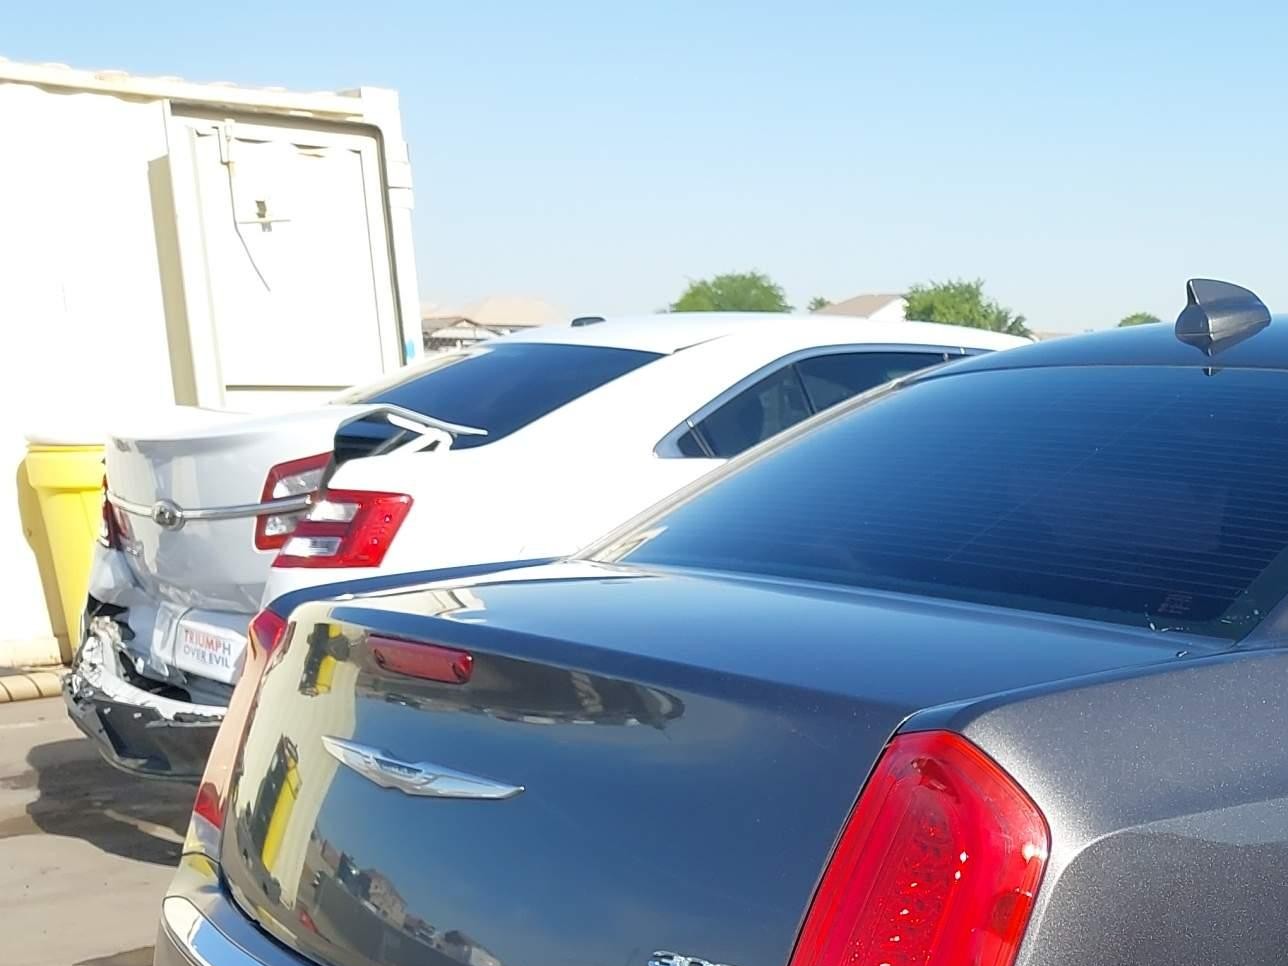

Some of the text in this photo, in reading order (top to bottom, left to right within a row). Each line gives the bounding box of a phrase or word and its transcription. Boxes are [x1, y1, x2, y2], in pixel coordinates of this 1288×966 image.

[184, 629, 232, 656] TRIUMPH
[183, 643, 231, 669] OVER EVIL
